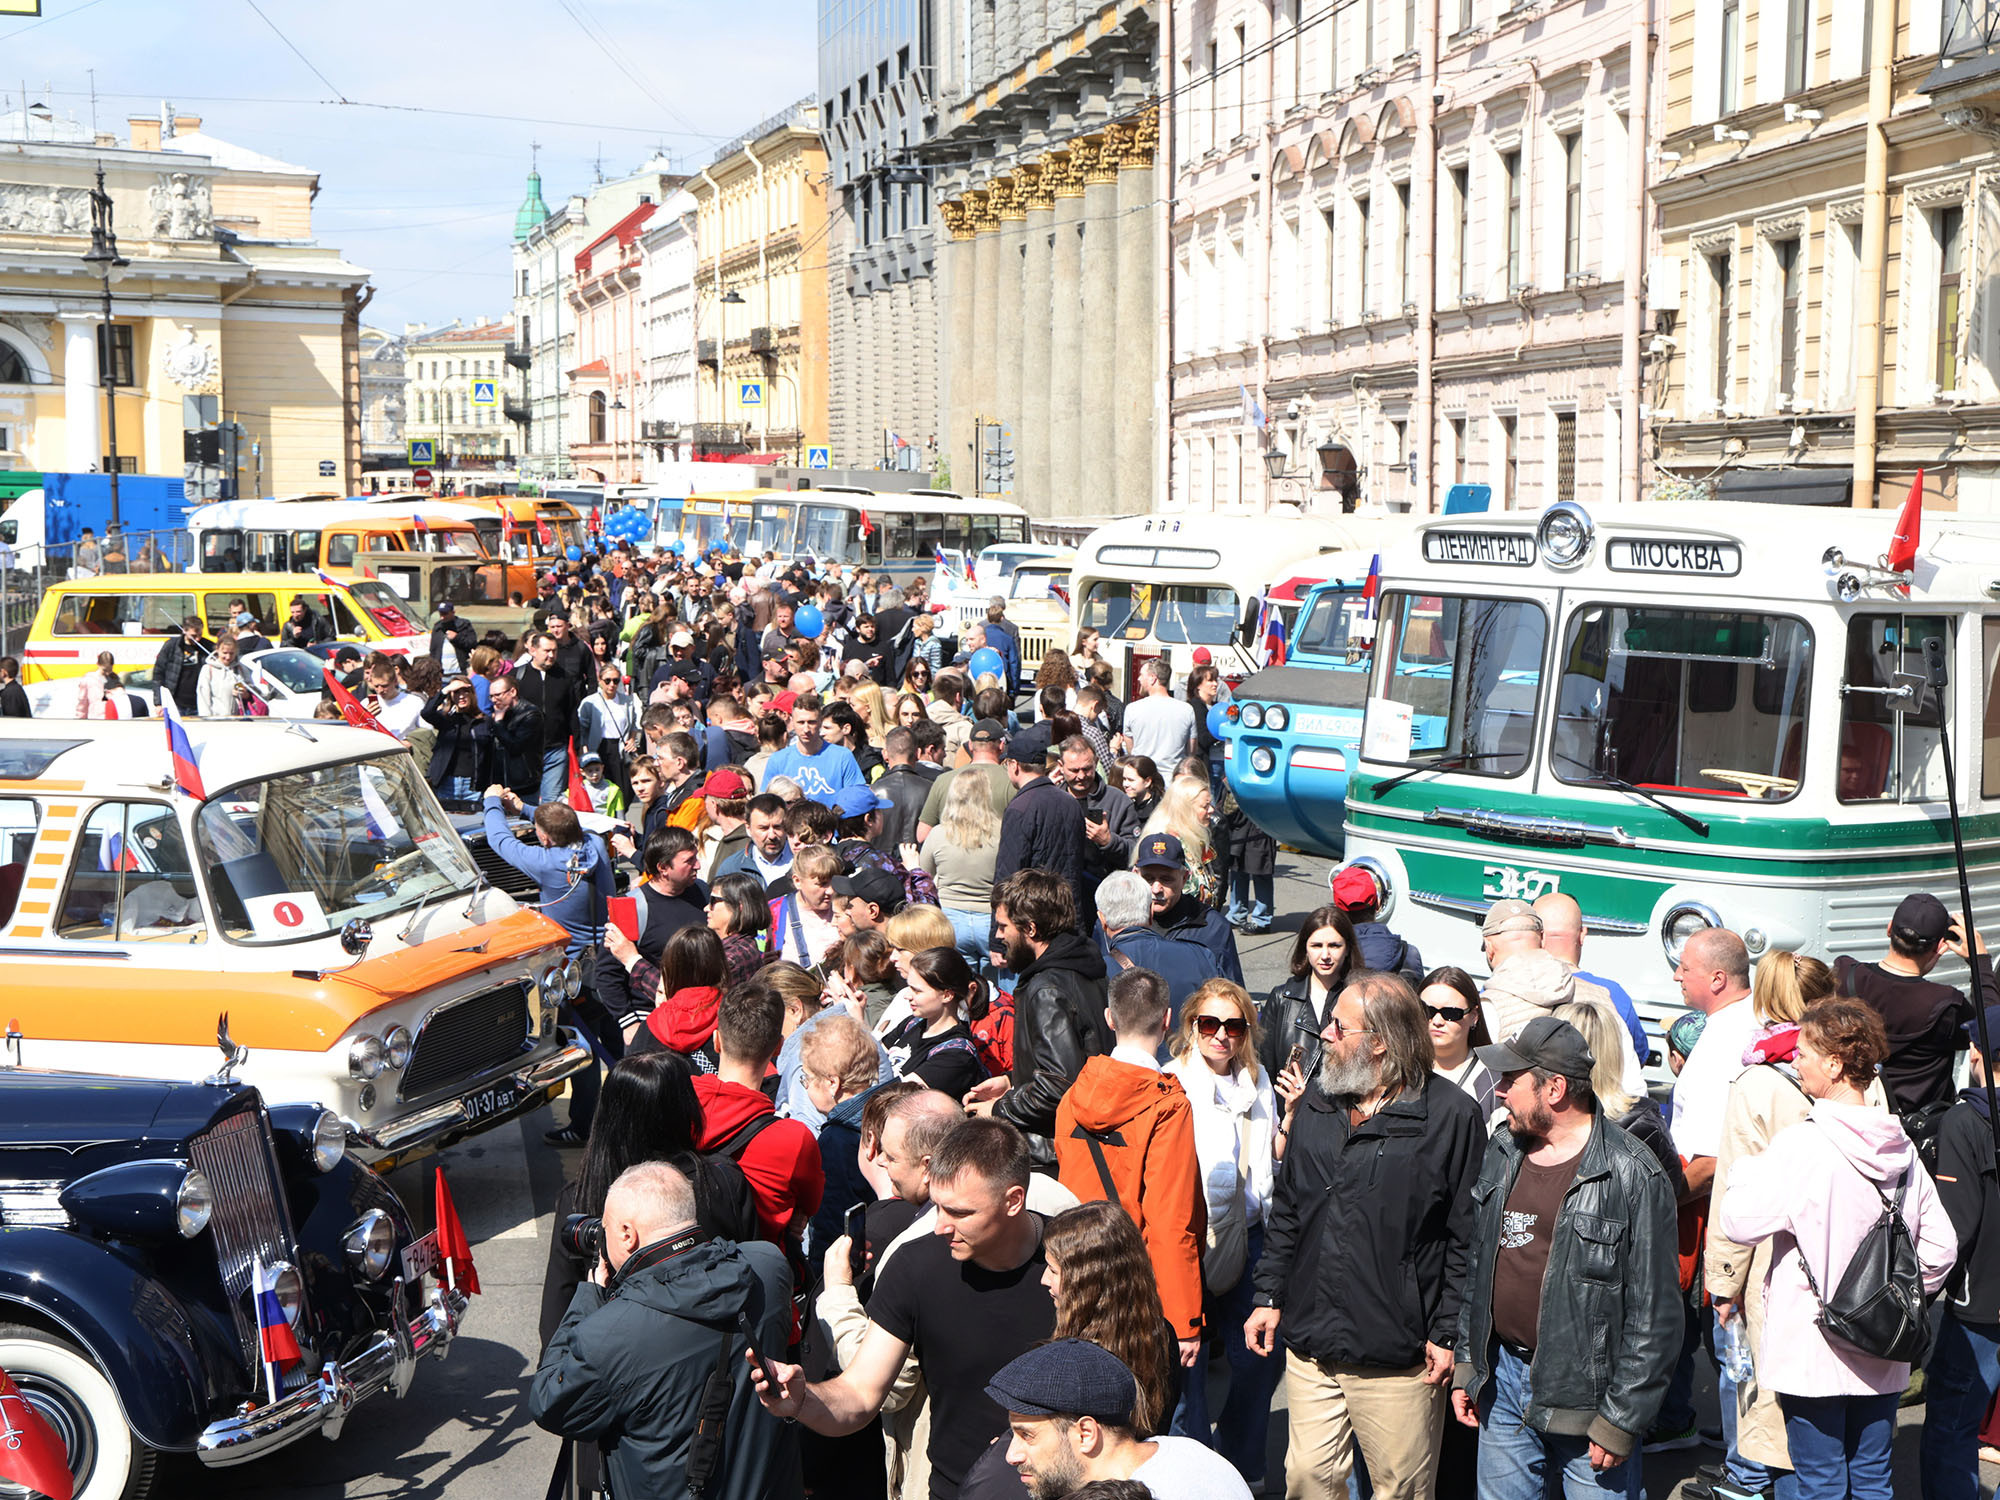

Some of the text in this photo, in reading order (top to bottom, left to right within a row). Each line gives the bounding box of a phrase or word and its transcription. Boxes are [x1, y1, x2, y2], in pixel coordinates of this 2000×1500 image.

[1439, 535, 1528, 563] ЛЕНИНГРАД
[1629, 541, 1724, 572] МОСКВА
[281, 905, 295, 924] 1
[671, 1237, 695, 1251] Canon
